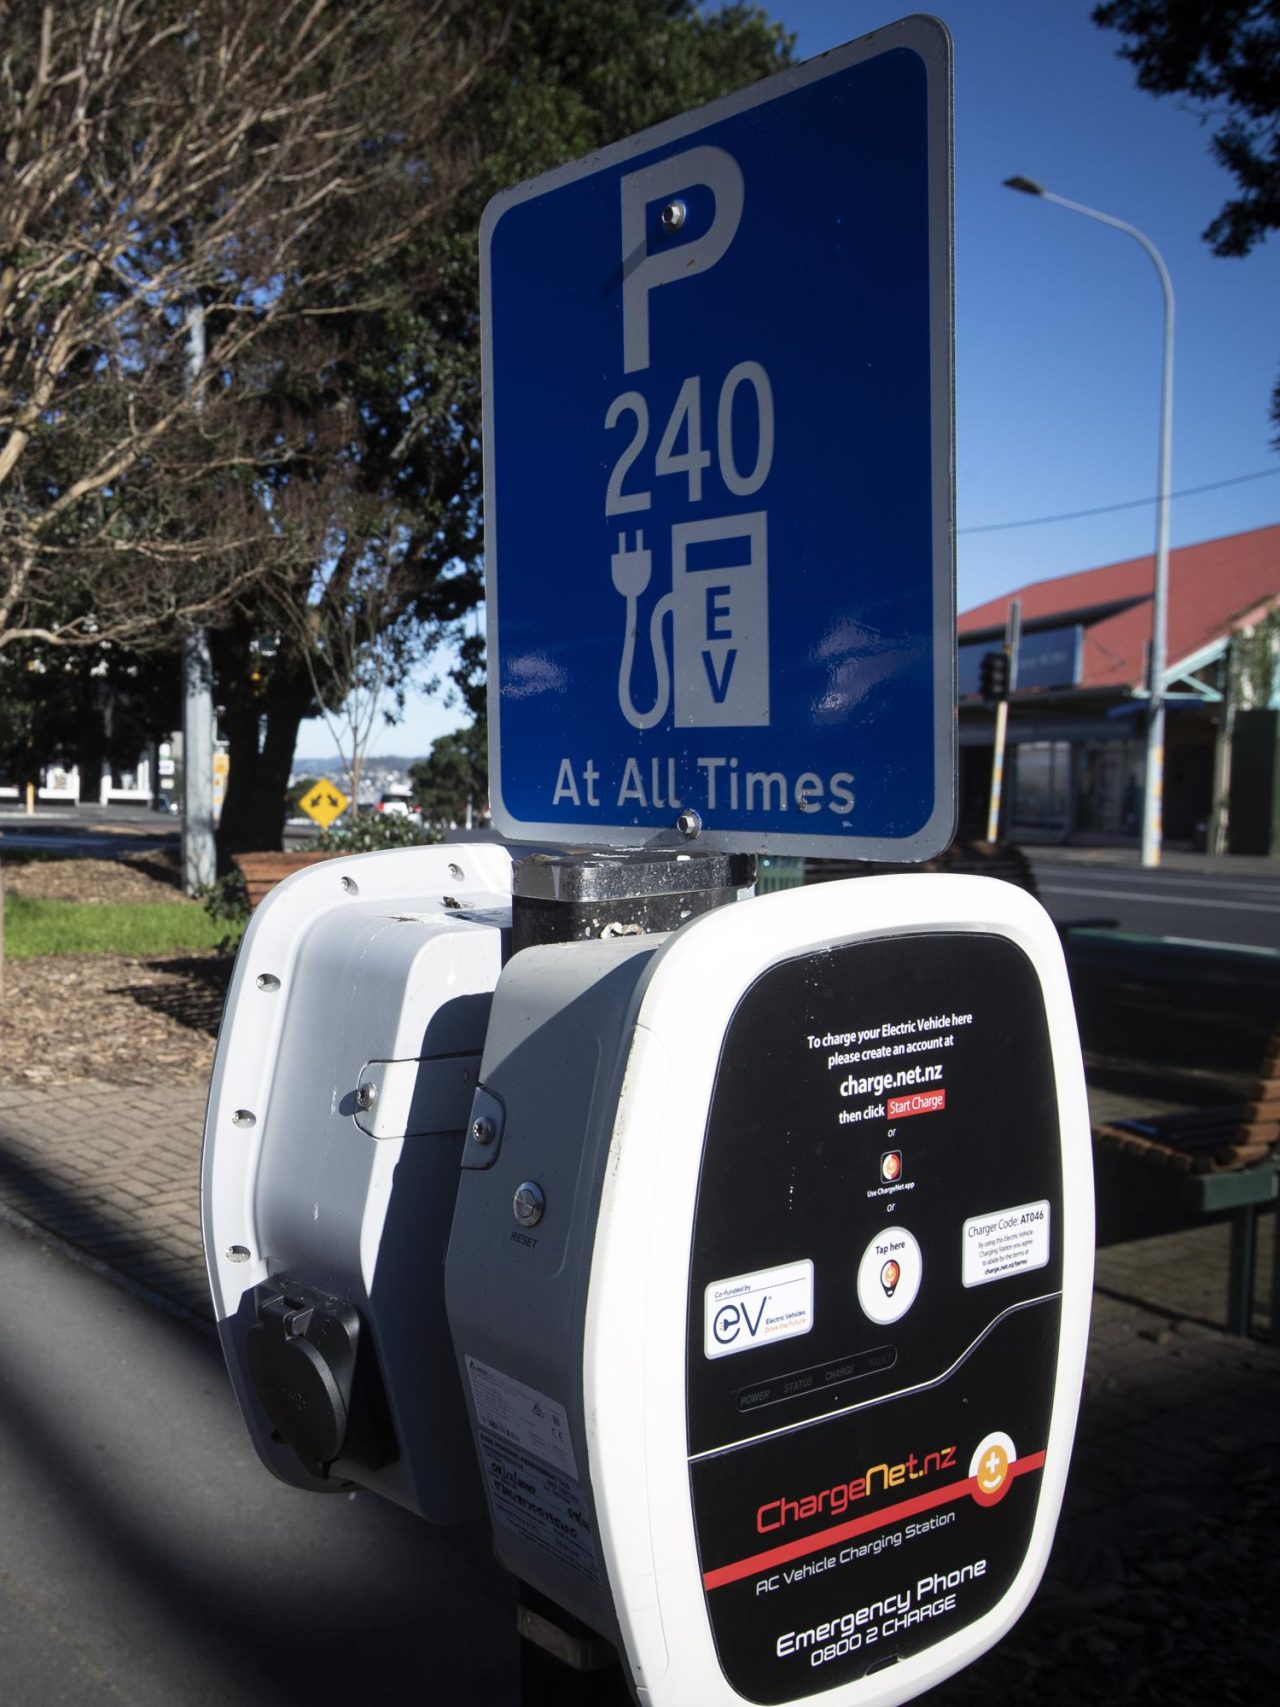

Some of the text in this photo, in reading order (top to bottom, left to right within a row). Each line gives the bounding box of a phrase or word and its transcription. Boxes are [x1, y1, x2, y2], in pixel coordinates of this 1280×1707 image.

[621, 145, 745, 374] P
[605, 360, 775, 516] 240
[552, 757, 855, 814] At All Times
[807, 1013, 972, 1049] To charge your Electric Vehicle here
[828, 1035, 954, 1069] please create an account at
[840, 1065, 943, 1096] charge.net.nz
[839, 1095, 943, 1124] then click Start Charge
[888, 1129, 896, 1137] or
[877, 1184, 904, 1195] ChargeNet
[905, 1182, 915, 1190] app
[887, 1203, 895, 1212] or
[968, 1210, 1044, 1237] Charger Code: AT046
[511, 1231, 538, 1248] RESET
[876, 1241, 905, 1255] Tap here
[980, 1249, 998, 1257] Charging
[714, 1285, 744, 1298] Co-funded
[765, 1310, 806, 1325] Electric Vehicles
[740, 1390, 770, 1406] POWER
[784, 1376, 815, 1393] STATUS
[825, 1364, 855, 1381] CHARGE
[757, 1446, 956, 1533] ChargeNet.nz
[756, 1512, 955, 1595] AC Vehicle Charging Station
[777, 1560, 987, 1657] Emergency Phone
[811, 1594, 956, 1667] 0800 2 CHARGE
